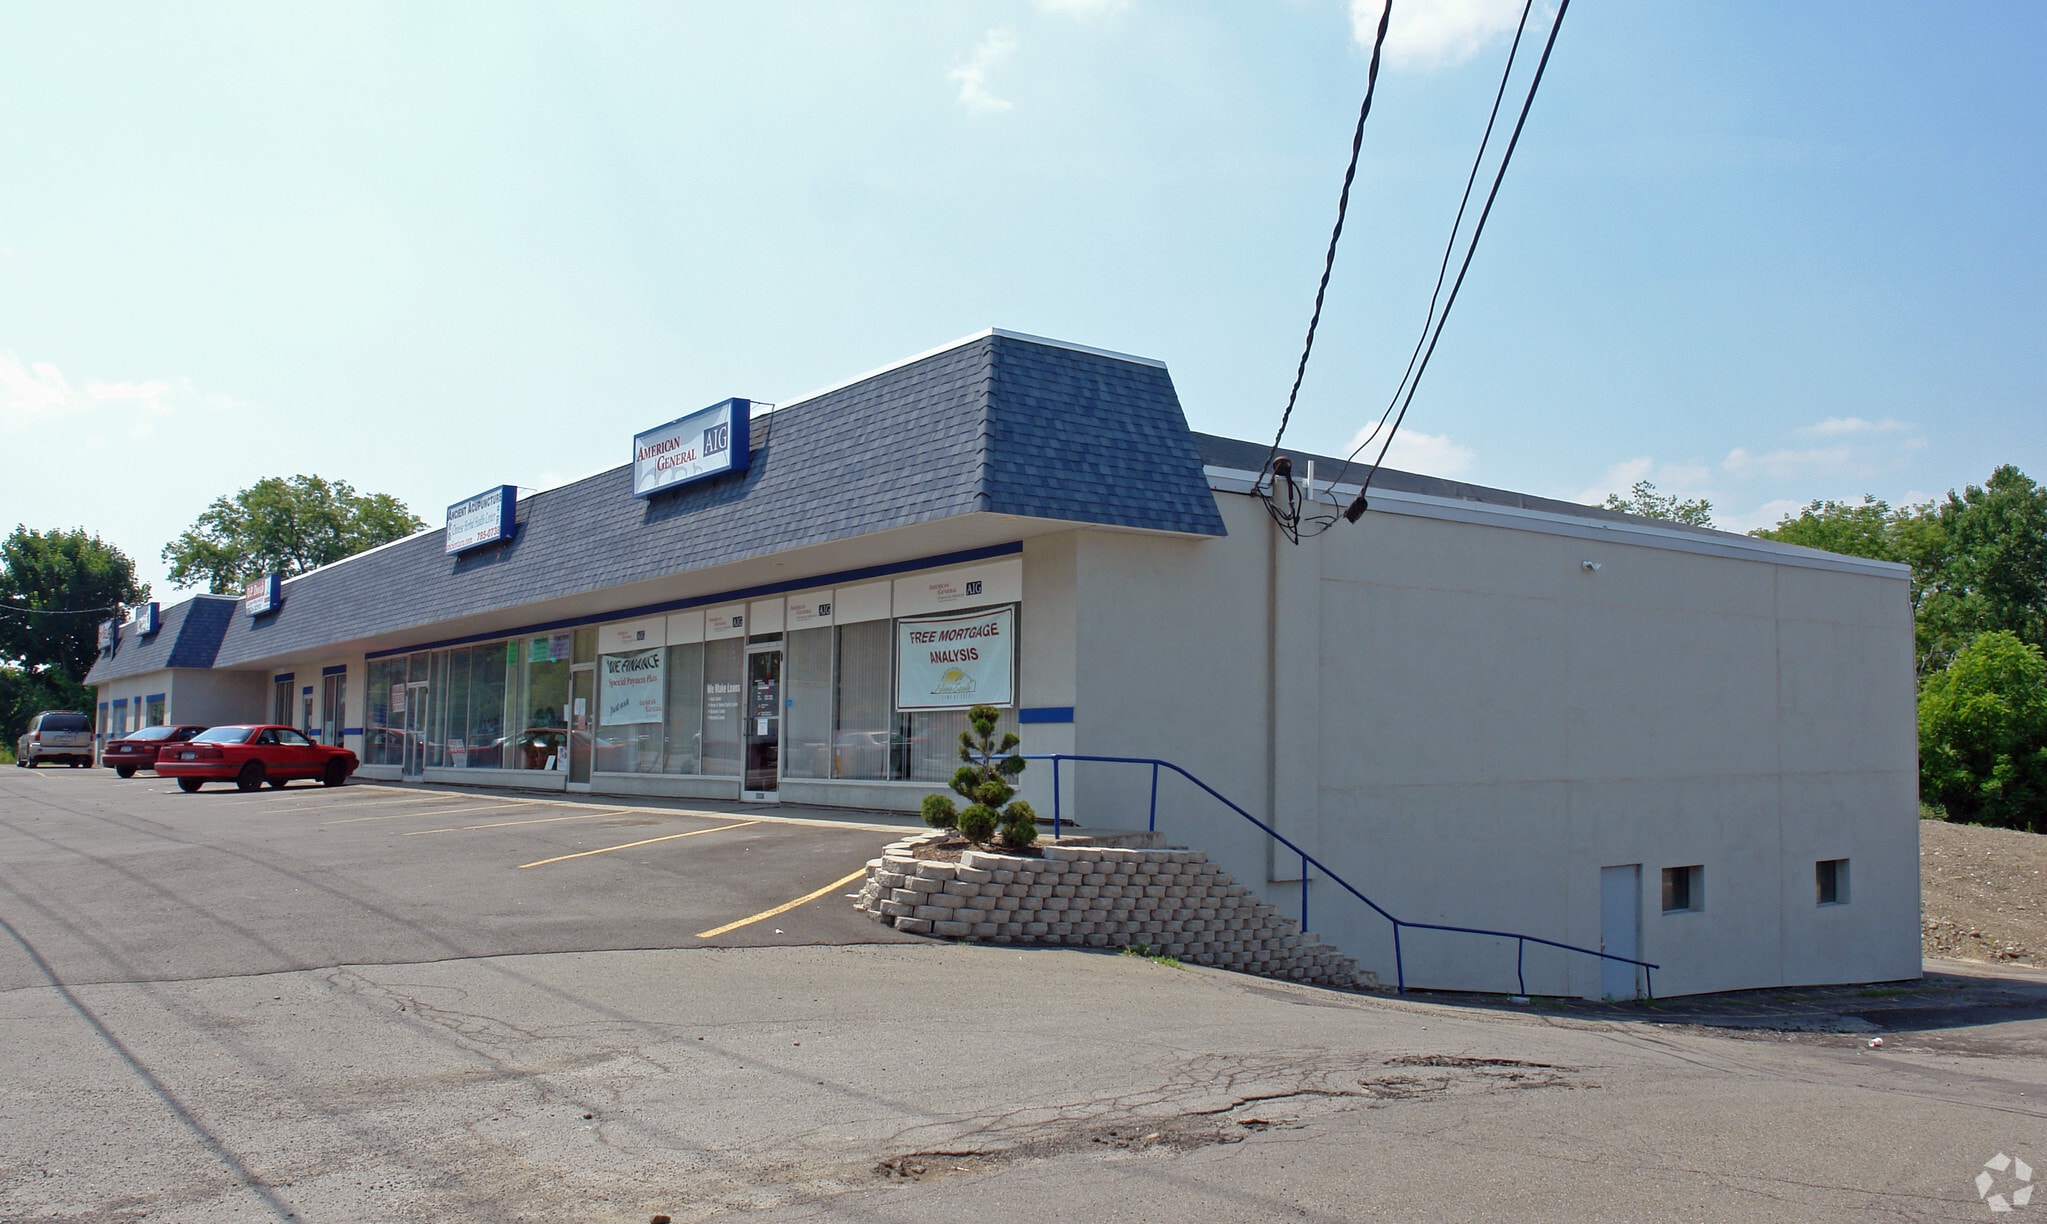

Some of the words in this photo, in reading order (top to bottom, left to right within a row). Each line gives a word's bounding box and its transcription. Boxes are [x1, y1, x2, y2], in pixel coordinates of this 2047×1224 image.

[636, 435, 681, 462] AMERICAN
[704, 426, 728, 454] AIG
[657, 448, 697, 471] GENERAL
[967, 582, 982, 595] AIG
[819, 604, 831, 616] AIG
[909, 631, 937, 644] FREE
[938, 622, 999, 642] MORTGAGE
[607, 659, 621, 674] WE
[621, 654, 660, 673] FINANCE
[929, 647, 979, 663] ANALYSIS
